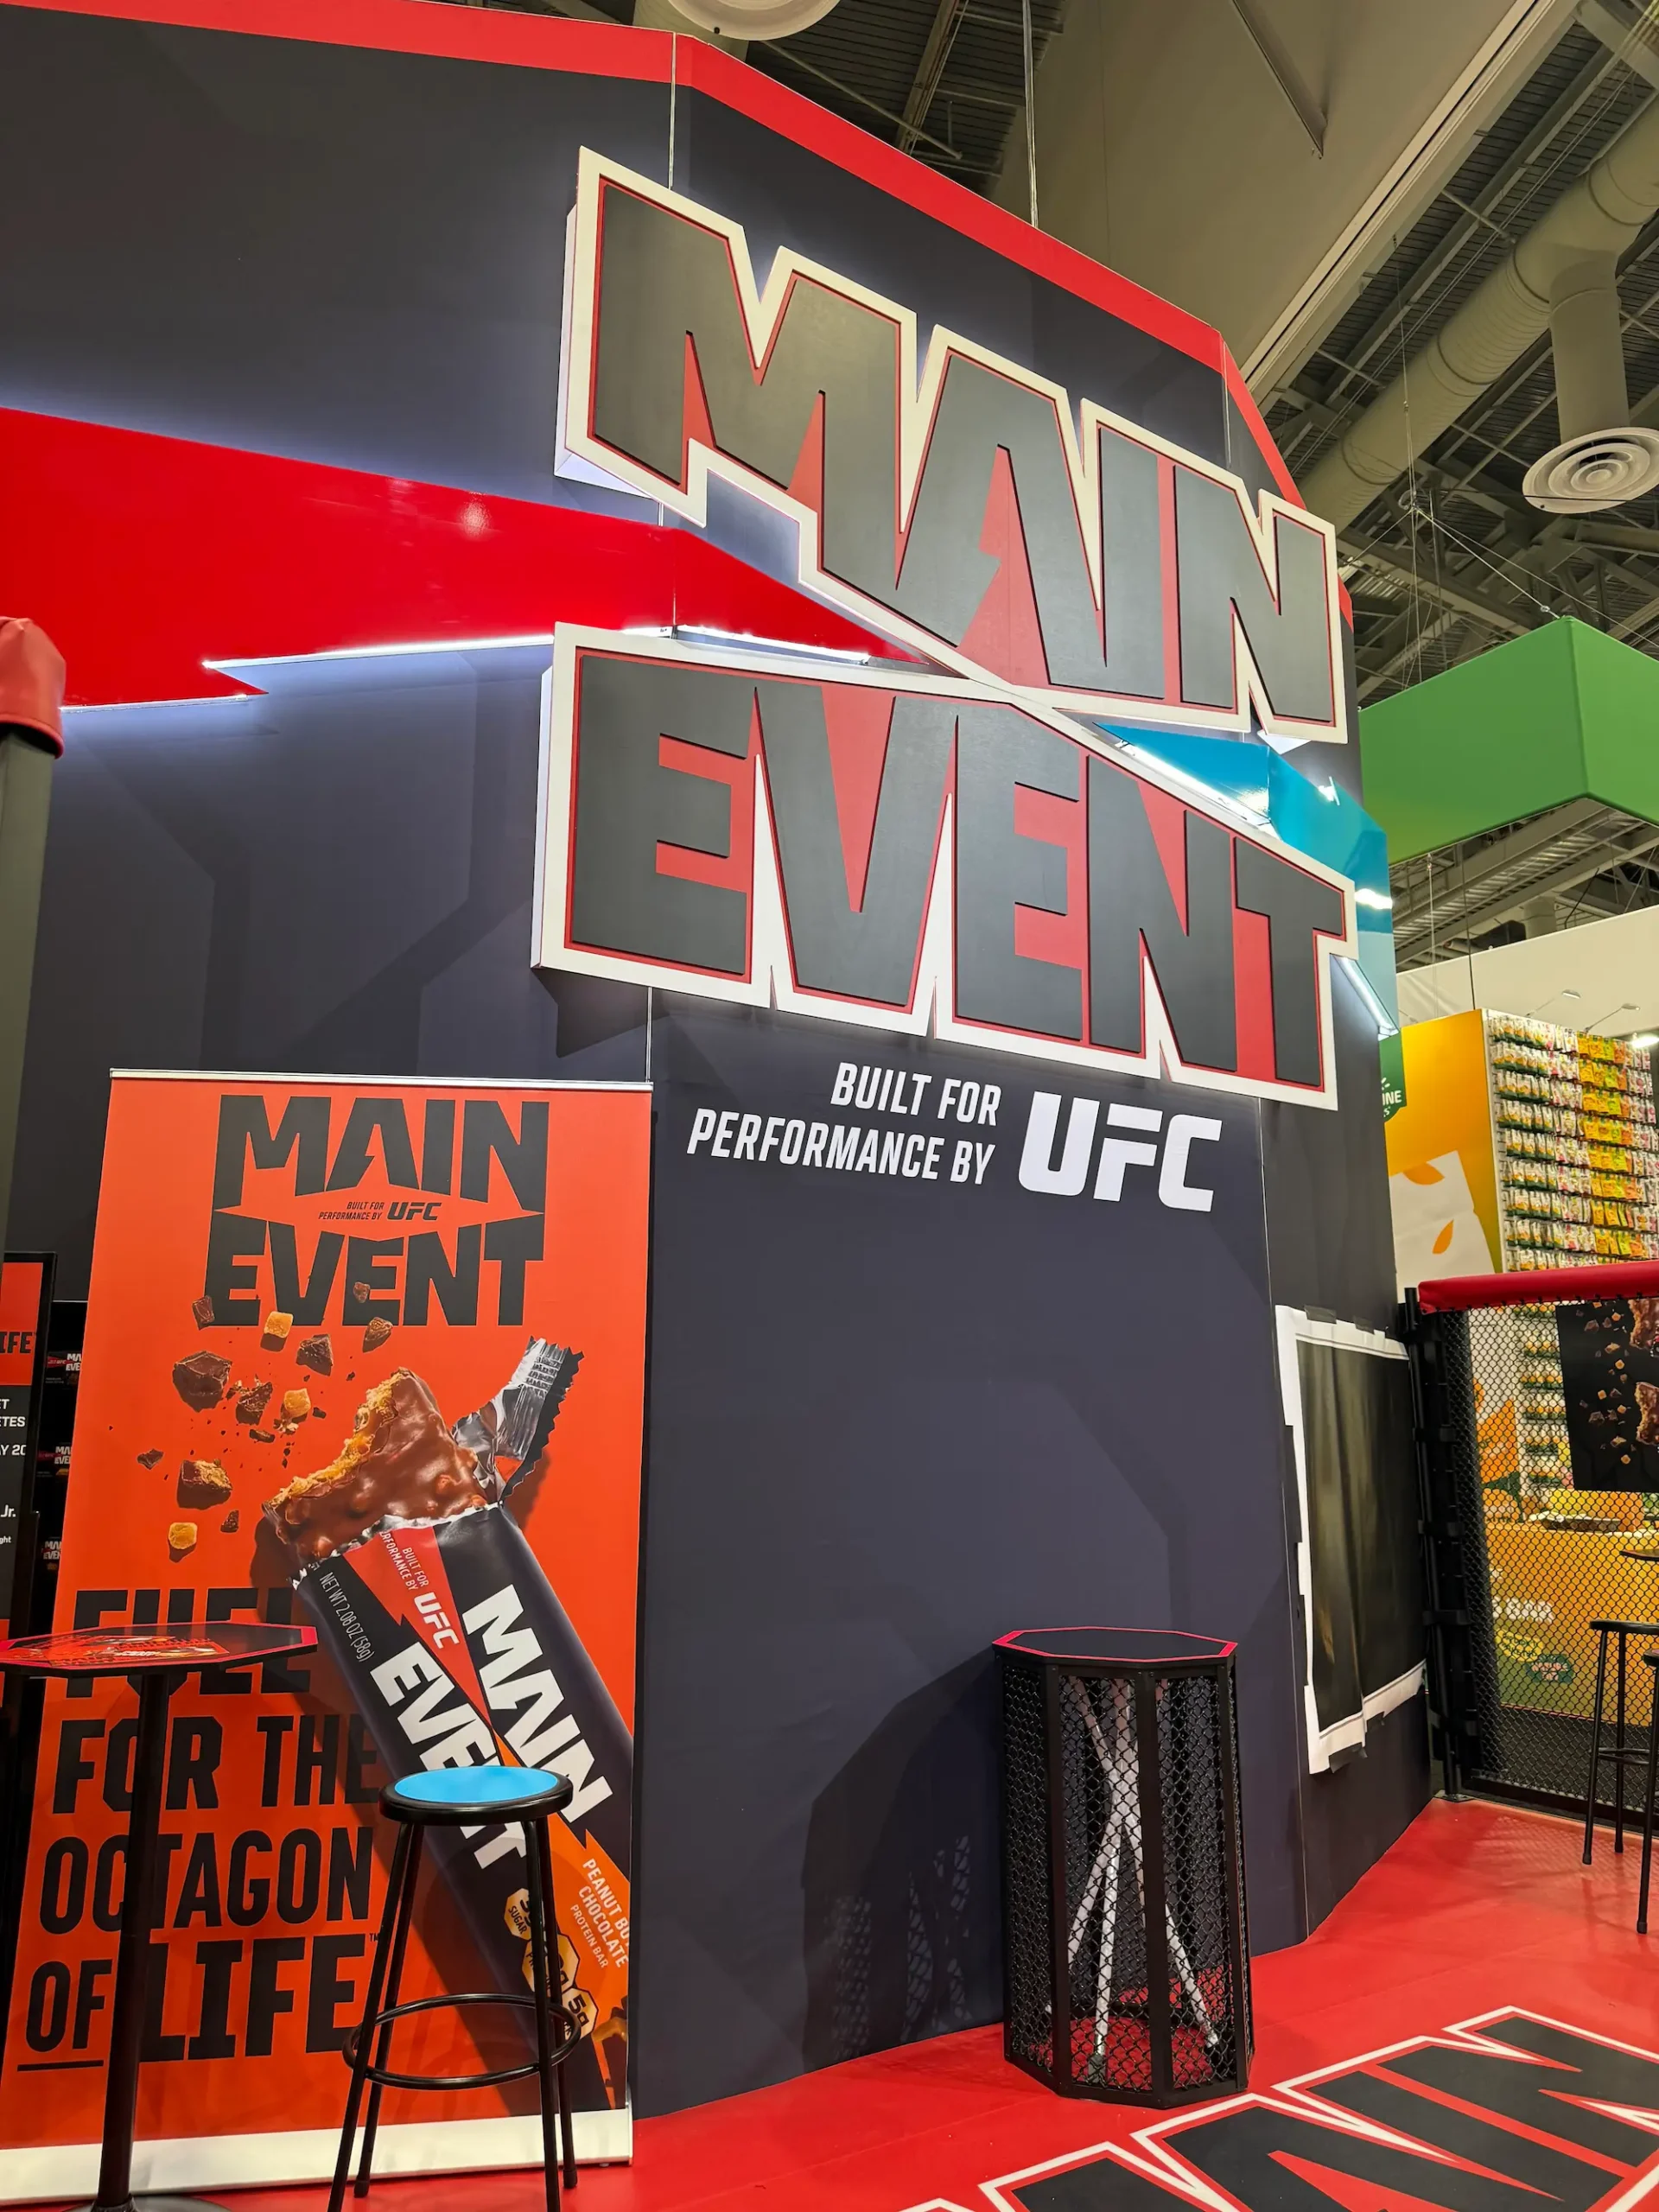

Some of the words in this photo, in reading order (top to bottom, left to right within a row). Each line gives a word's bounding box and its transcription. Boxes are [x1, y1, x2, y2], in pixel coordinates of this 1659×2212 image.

[589, 177, 1335, 726] MAIN
[567, 653, 1346, 1087] EVENT
[830, 1062, 931, 1116] BUILT
[938, 1077, 1002, 1126] FOR
[213, 1094, 550, 1211] MAIN
[687, 1108, 939, 1180] PERFORMANCE
[950, 1141, 995, 1185] BY
[1018, 1090, 1223, 1212] UFC
[318, 1211, 371, 1220] PERFORMANCE
[372, 1211, 383, 1220] BY
[346, 1201, 369, 1211] BUILT
[369, 1201, 385, 1211] FOR
[387, 1201, 442, 1221] UFC
[202, 1211, 545, 1326] EVENT
[0, 1504, 16, 1517] Jr.
[319, 1572, 340, 1593] NET
[402, 1547, 422, 1573] BUILT
[414, 1570, 429, 1587] FOR
[405, 1580, 419, 1591] BY
[328, 1588, 347, 1607] WT
[335, 1603, 358, 1627] 2.08
[414, 1592, 460, 1649] UFC
[346, 1622, 364, 1640] OZ
[350, 1636, 375, 1662] (58g)
[462, 1584, 613, 1823] MAIN
[257, 1714, 381, 1808] THE
[370, 1642, 527, 1870] EVET
[582, 1858, 622, 1916] PEANUT
[508, 1905, 528, 1935] SUGAR
[570, 1904, 598, 1948] PROTEIN
[593, 1946, 609, 1968] BAR
[578, 1885, 629, 1967] CHOCOLATE
[26, 1958, 113, 2053] OF
[140, 1934, 366, 2063] LIFE
